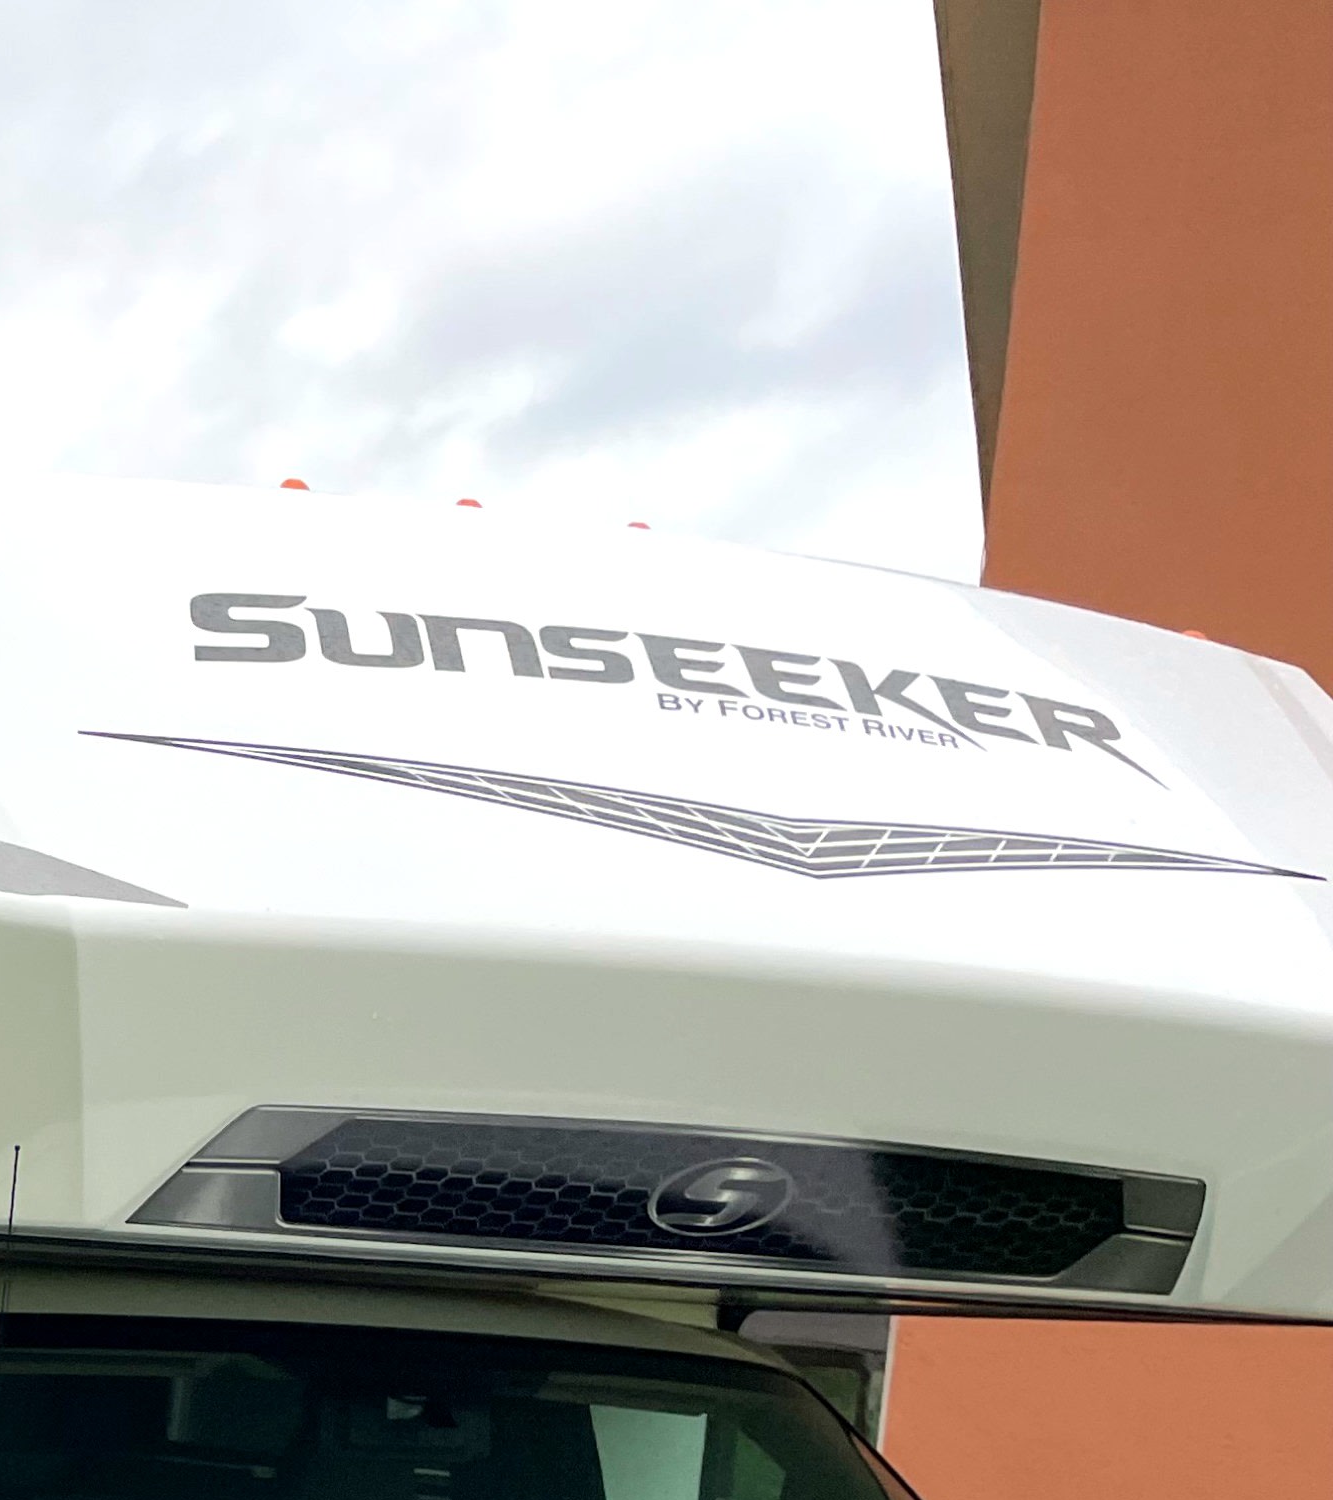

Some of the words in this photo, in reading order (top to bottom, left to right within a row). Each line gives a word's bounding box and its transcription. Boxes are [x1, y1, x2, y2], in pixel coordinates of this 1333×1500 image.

[189, 592, 1167, 788] SUNSEEKER
[656, 693, 704, 714] BY
[718, 699, 849, 732] FOREST
[862, 718, 960, 749] RIVER
